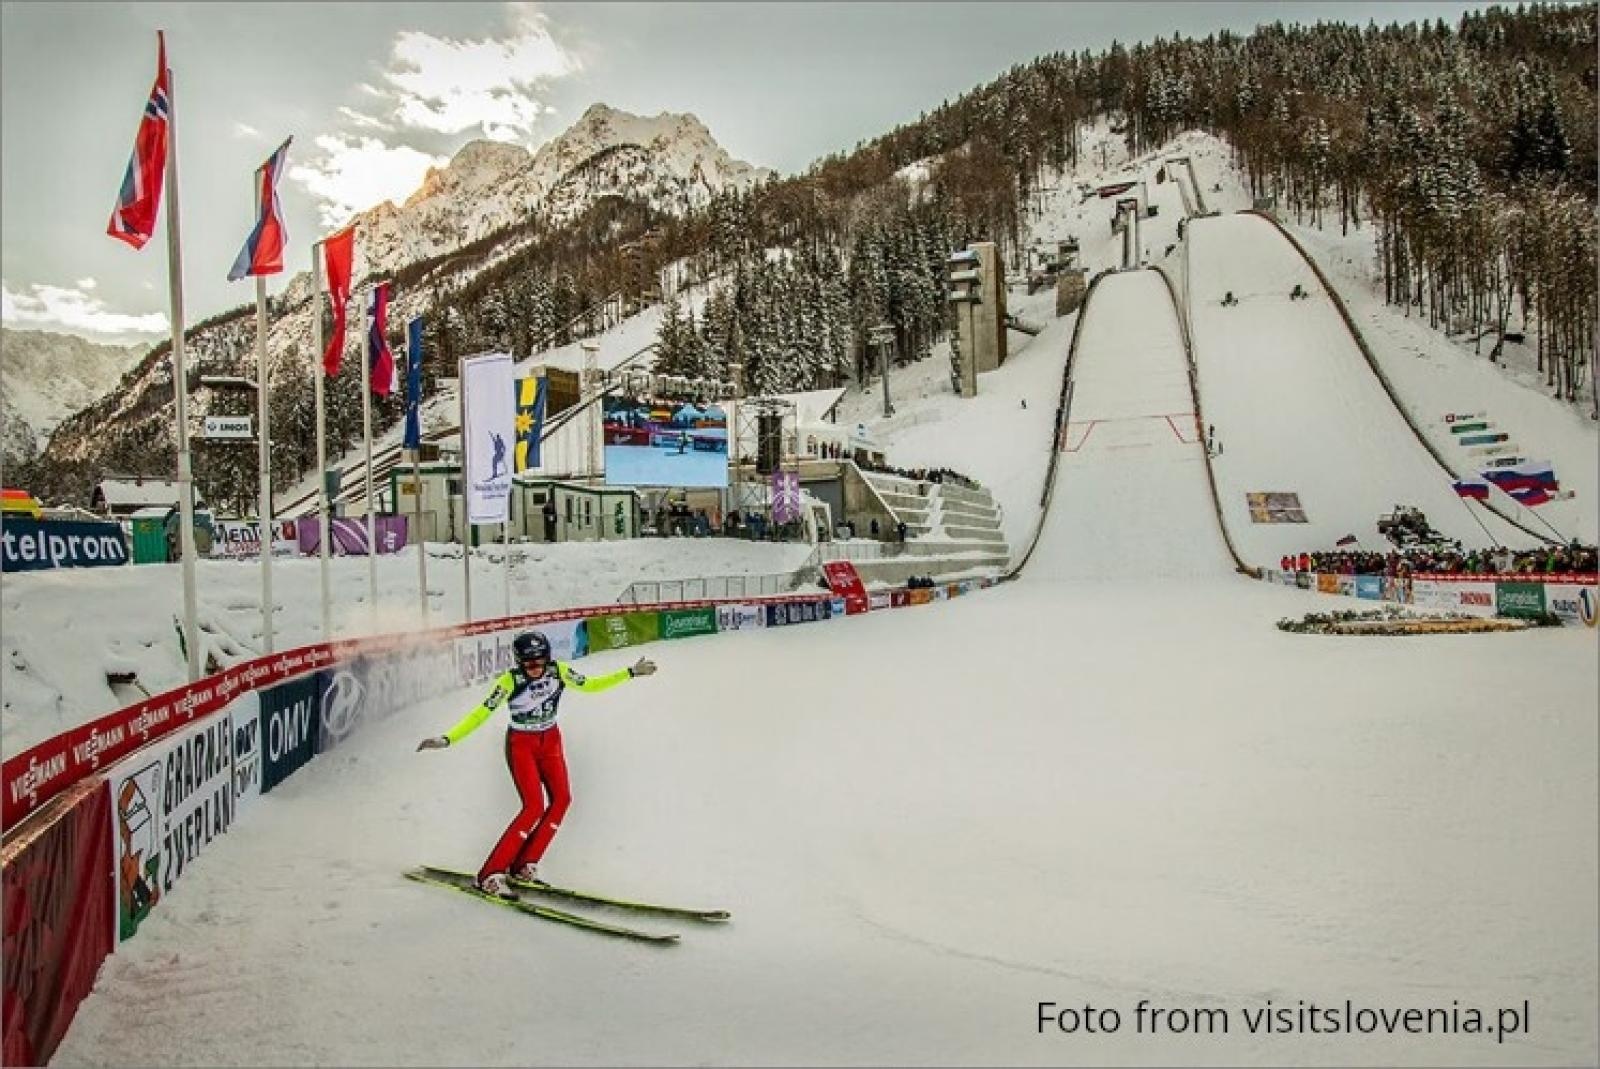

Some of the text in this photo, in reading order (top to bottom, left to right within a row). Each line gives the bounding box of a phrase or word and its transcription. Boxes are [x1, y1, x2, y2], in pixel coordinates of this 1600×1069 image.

[3, 529, 125, 569] telprom
[72, 728, 125, 770] VIESSMANN
[269, 697, 312, 762] OMV
[10, 755, 67, 808] VIESSMANN
[164, 717, 230, 817] GRADNJE
